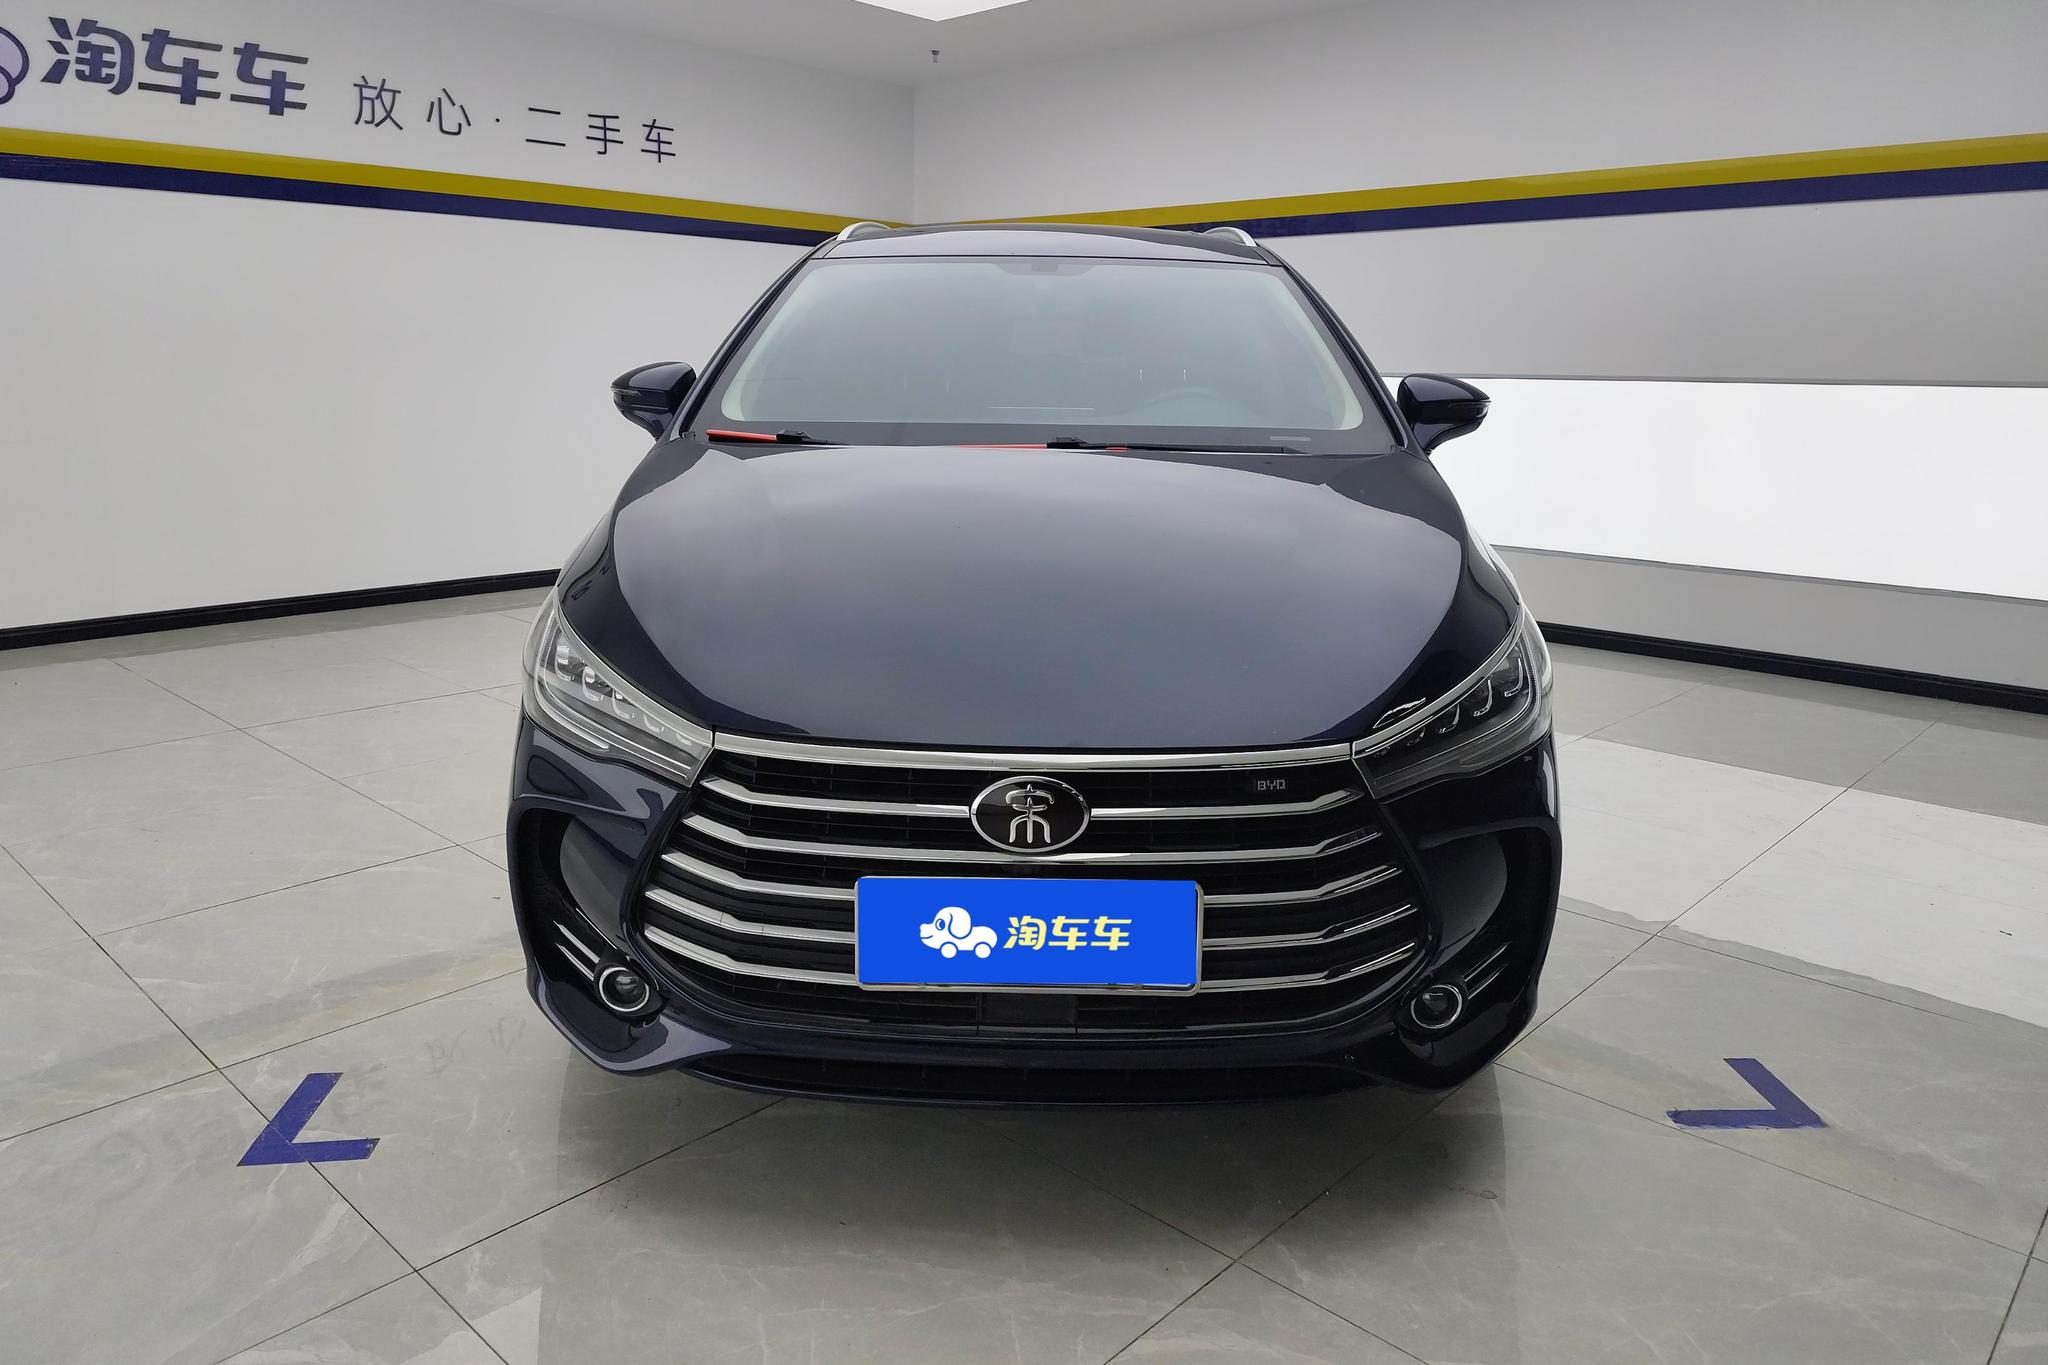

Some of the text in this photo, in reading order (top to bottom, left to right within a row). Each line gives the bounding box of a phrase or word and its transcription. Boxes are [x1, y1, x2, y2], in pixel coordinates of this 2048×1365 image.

[40, 16, 309, 116] 淘车车
[1257, 779, 1286, 791] BYD
